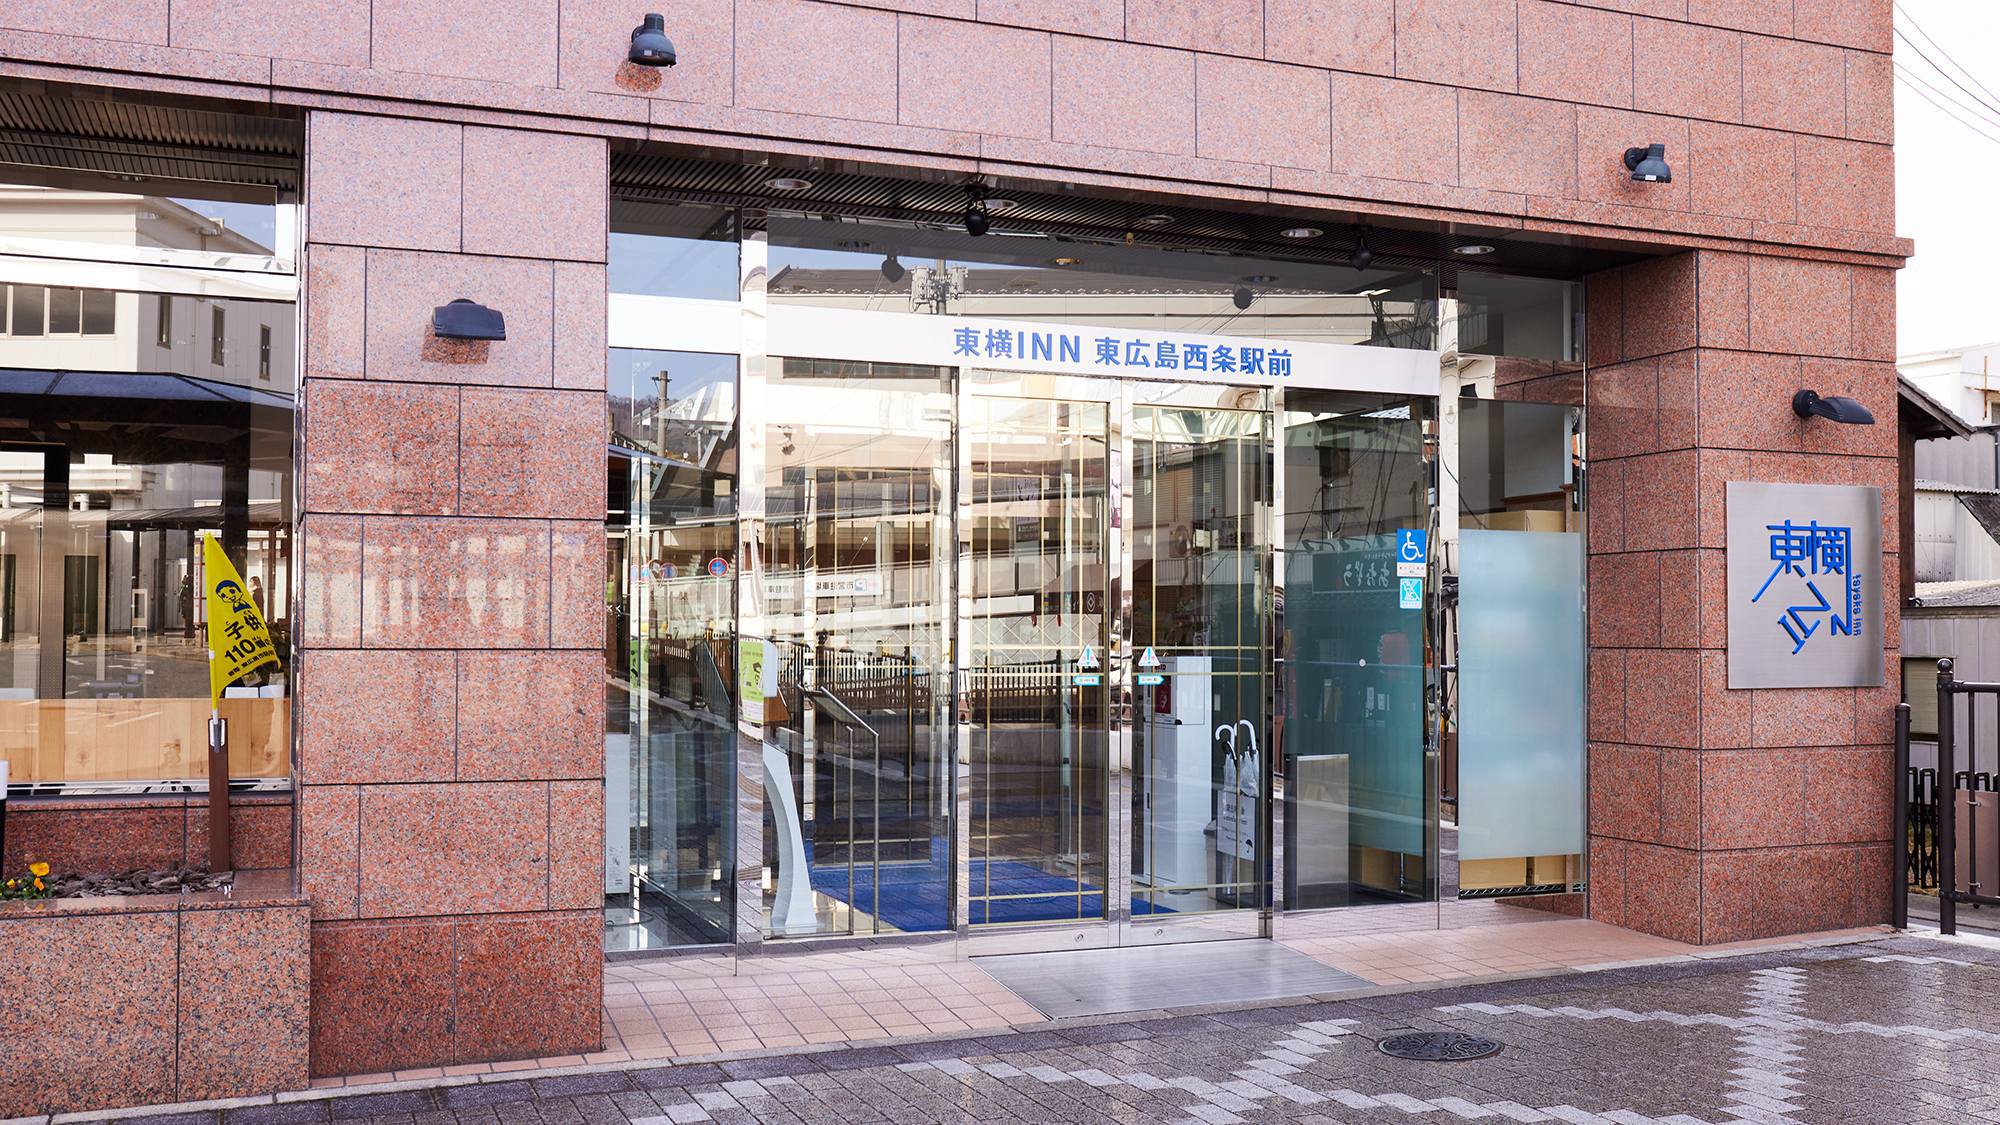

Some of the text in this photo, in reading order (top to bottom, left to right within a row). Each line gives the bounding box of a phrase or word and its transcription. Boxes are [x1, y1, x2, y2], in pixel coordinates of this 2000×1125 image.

[953, 326, 1292, 377] 東横INN 東広島西条駅前
[224, 613, 264, 640] 子供
